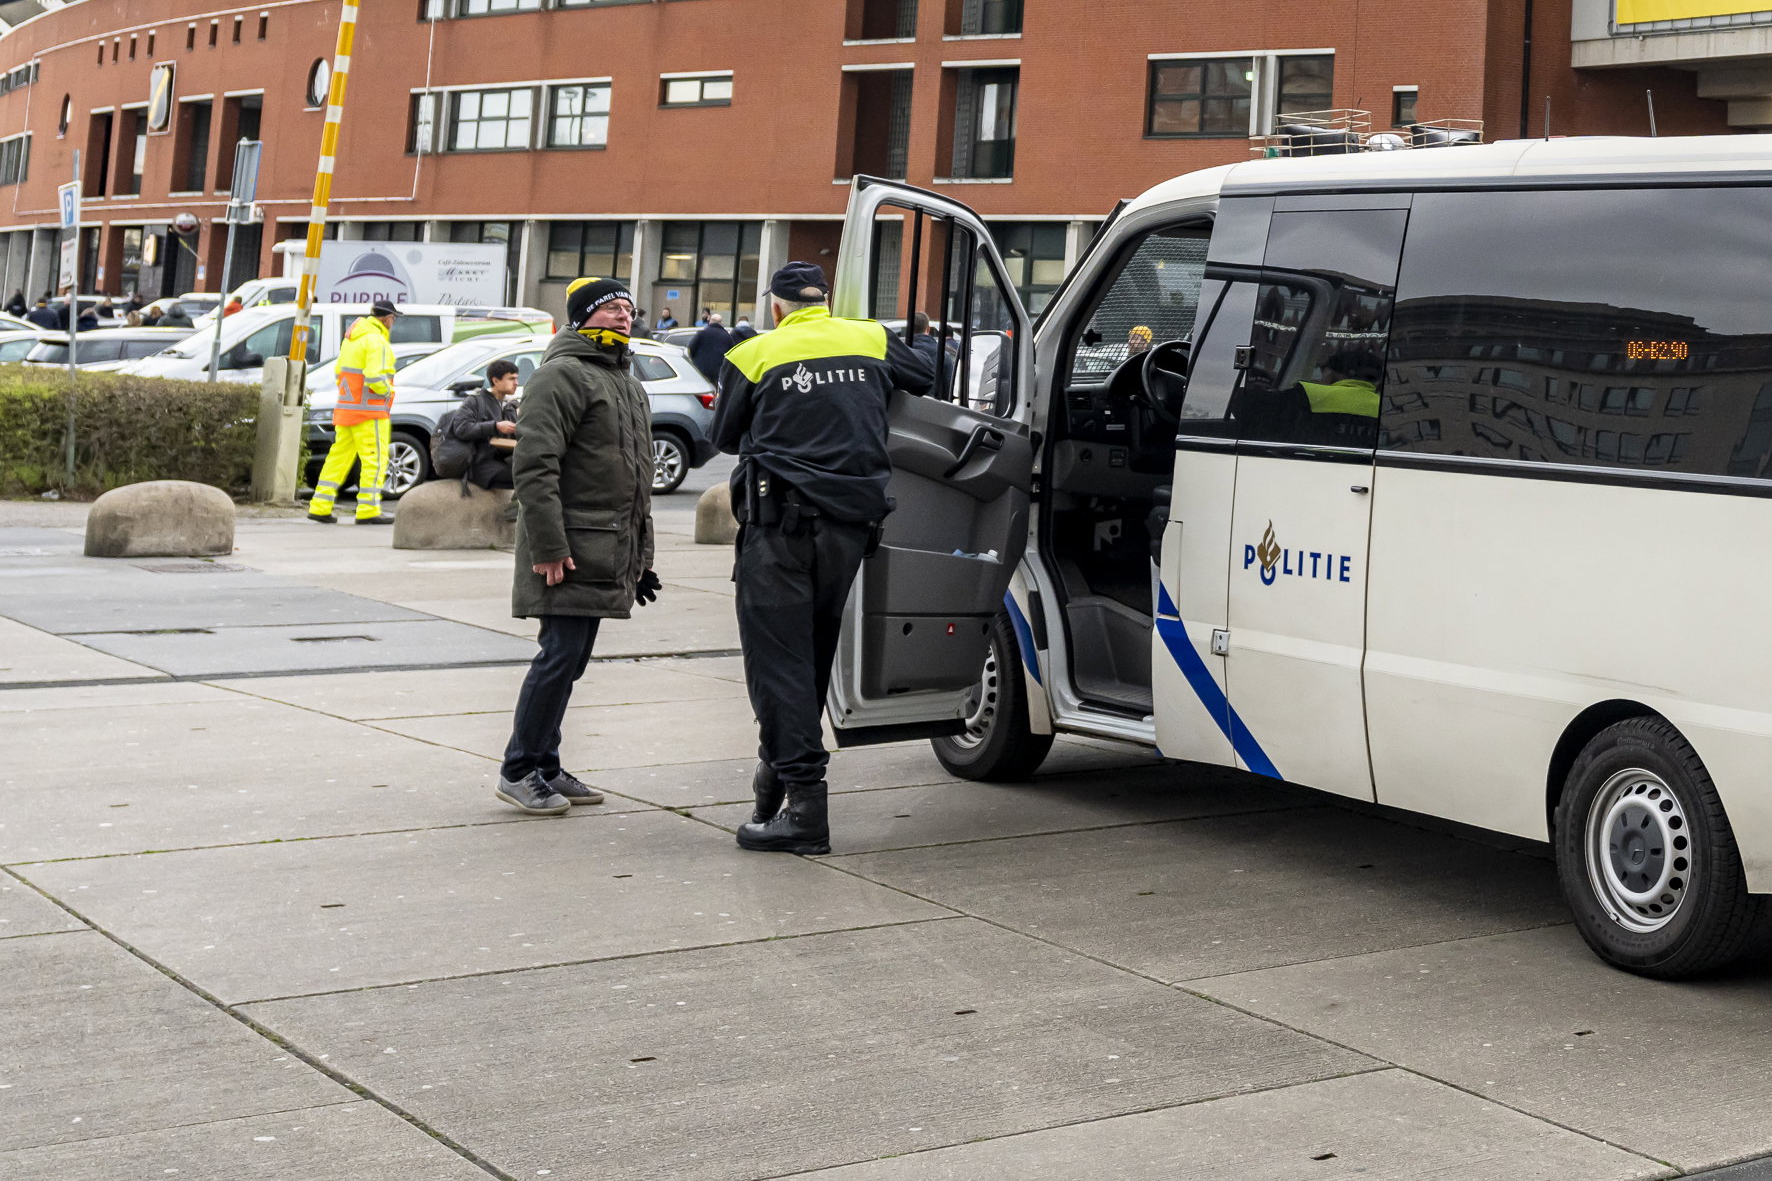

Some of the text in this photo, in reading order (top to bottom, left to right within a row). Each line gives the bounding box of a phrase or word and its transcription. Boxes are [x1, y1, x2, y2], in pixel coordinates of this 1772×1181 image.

[594, 293, 616, 306] PAREL
[781, 368, 866, 394] POLITIE
[1243, 544, 1351, 586] POLITIE
